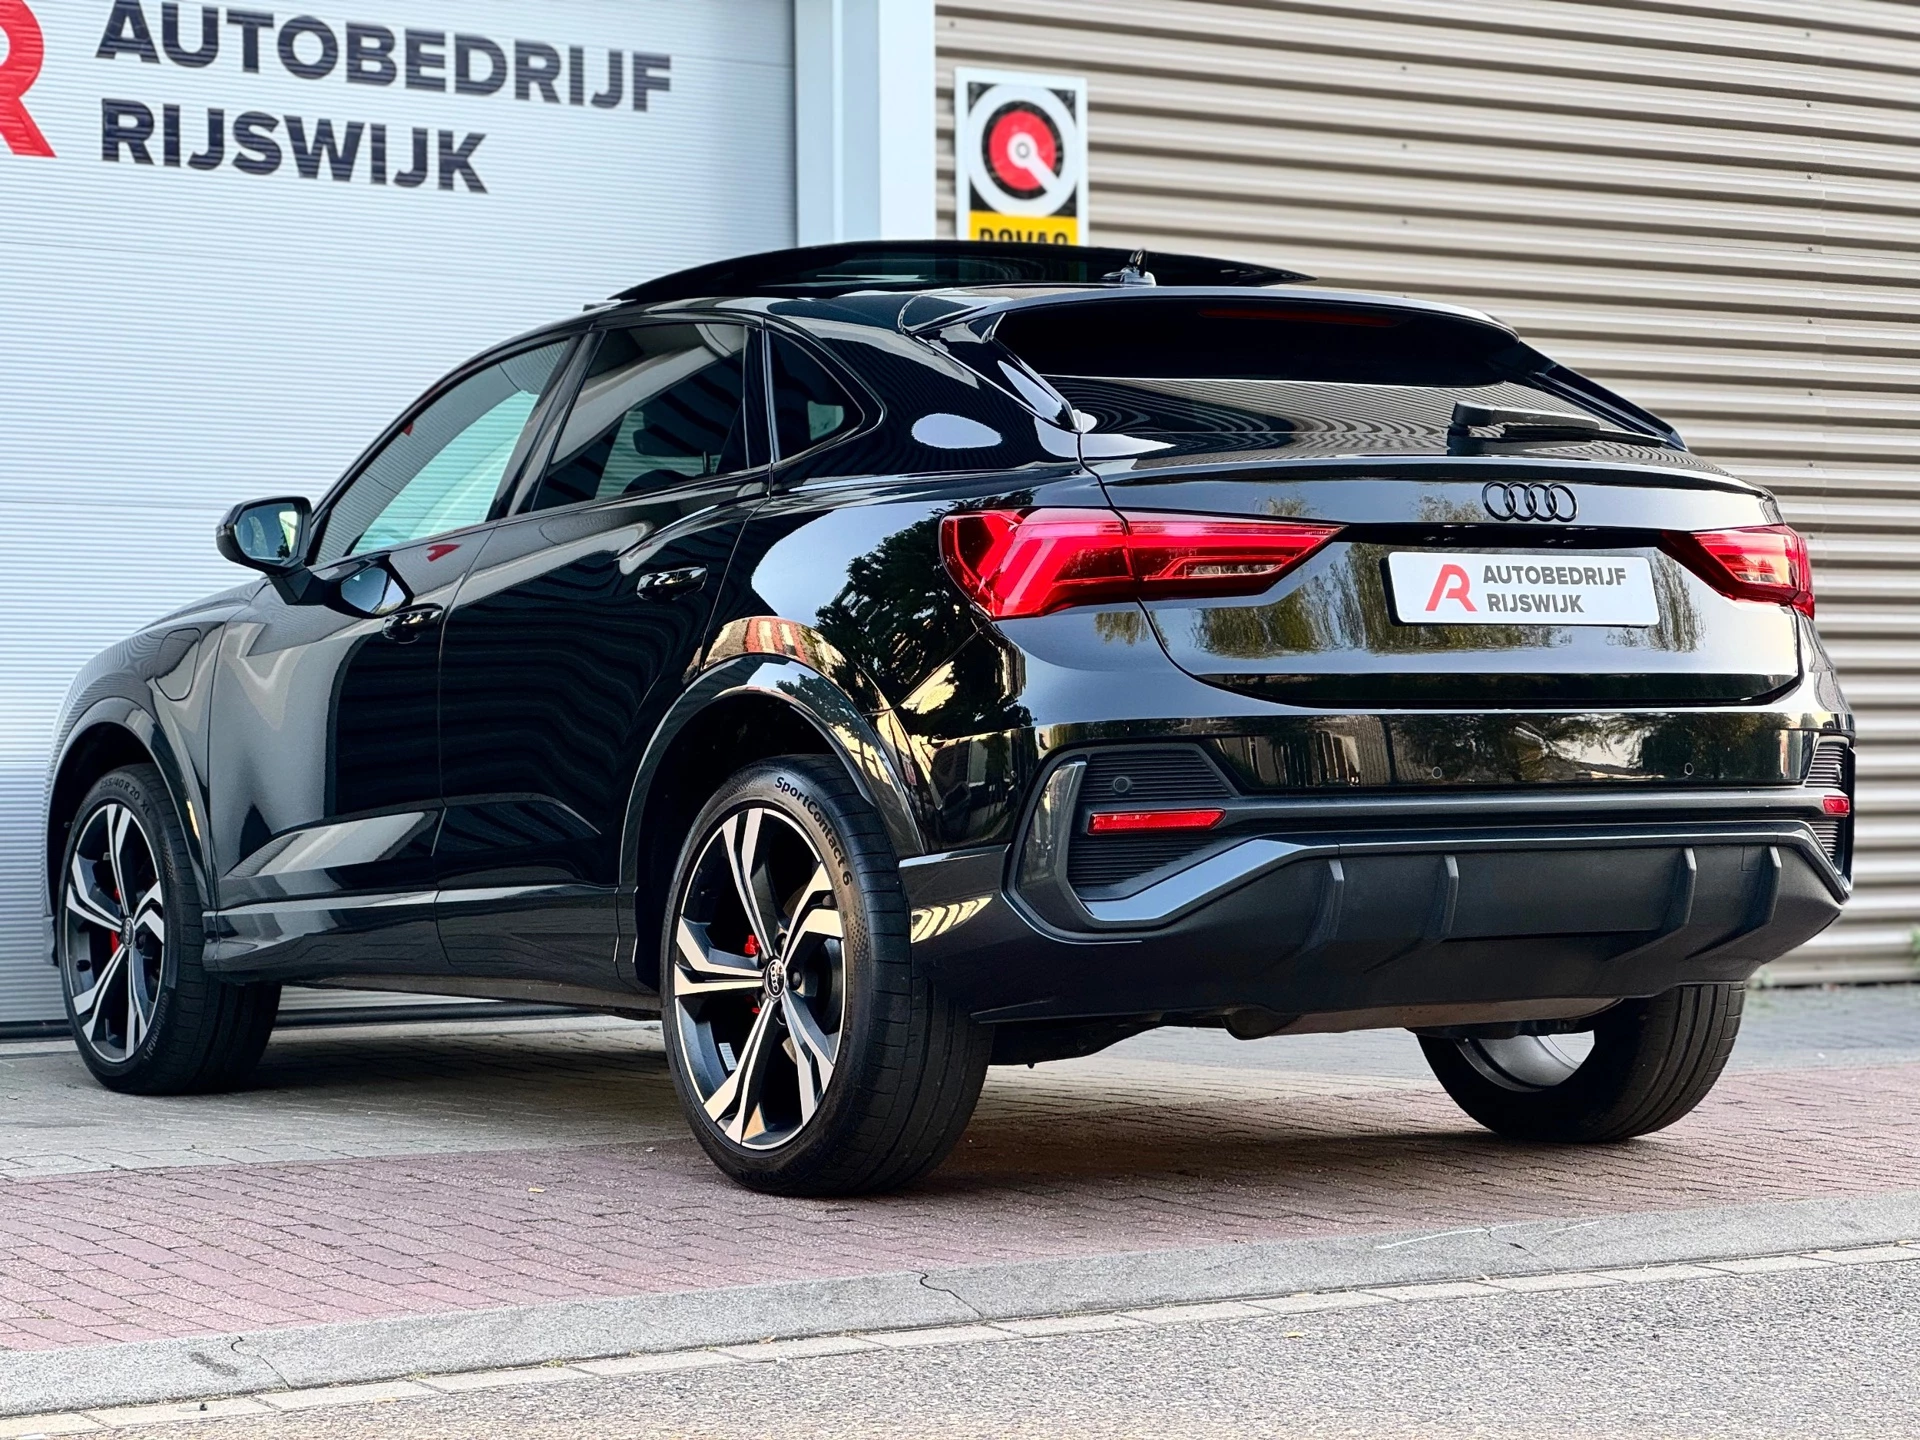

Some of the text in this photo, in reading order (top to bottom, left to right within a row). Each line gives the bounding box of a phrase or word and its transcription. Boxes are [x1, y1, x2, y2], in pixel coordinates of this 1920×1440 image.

[96, 0, 672, 113] AUTOBEDRIJF
[101, 97, 488, 194] RIJSWIJK
[1482, 564, 1627, 586] AUTOBEDRIJF
[1486, 593, 1585, 613] RIJSWIJK
[774, 776, 853, 886] SportContact 6
